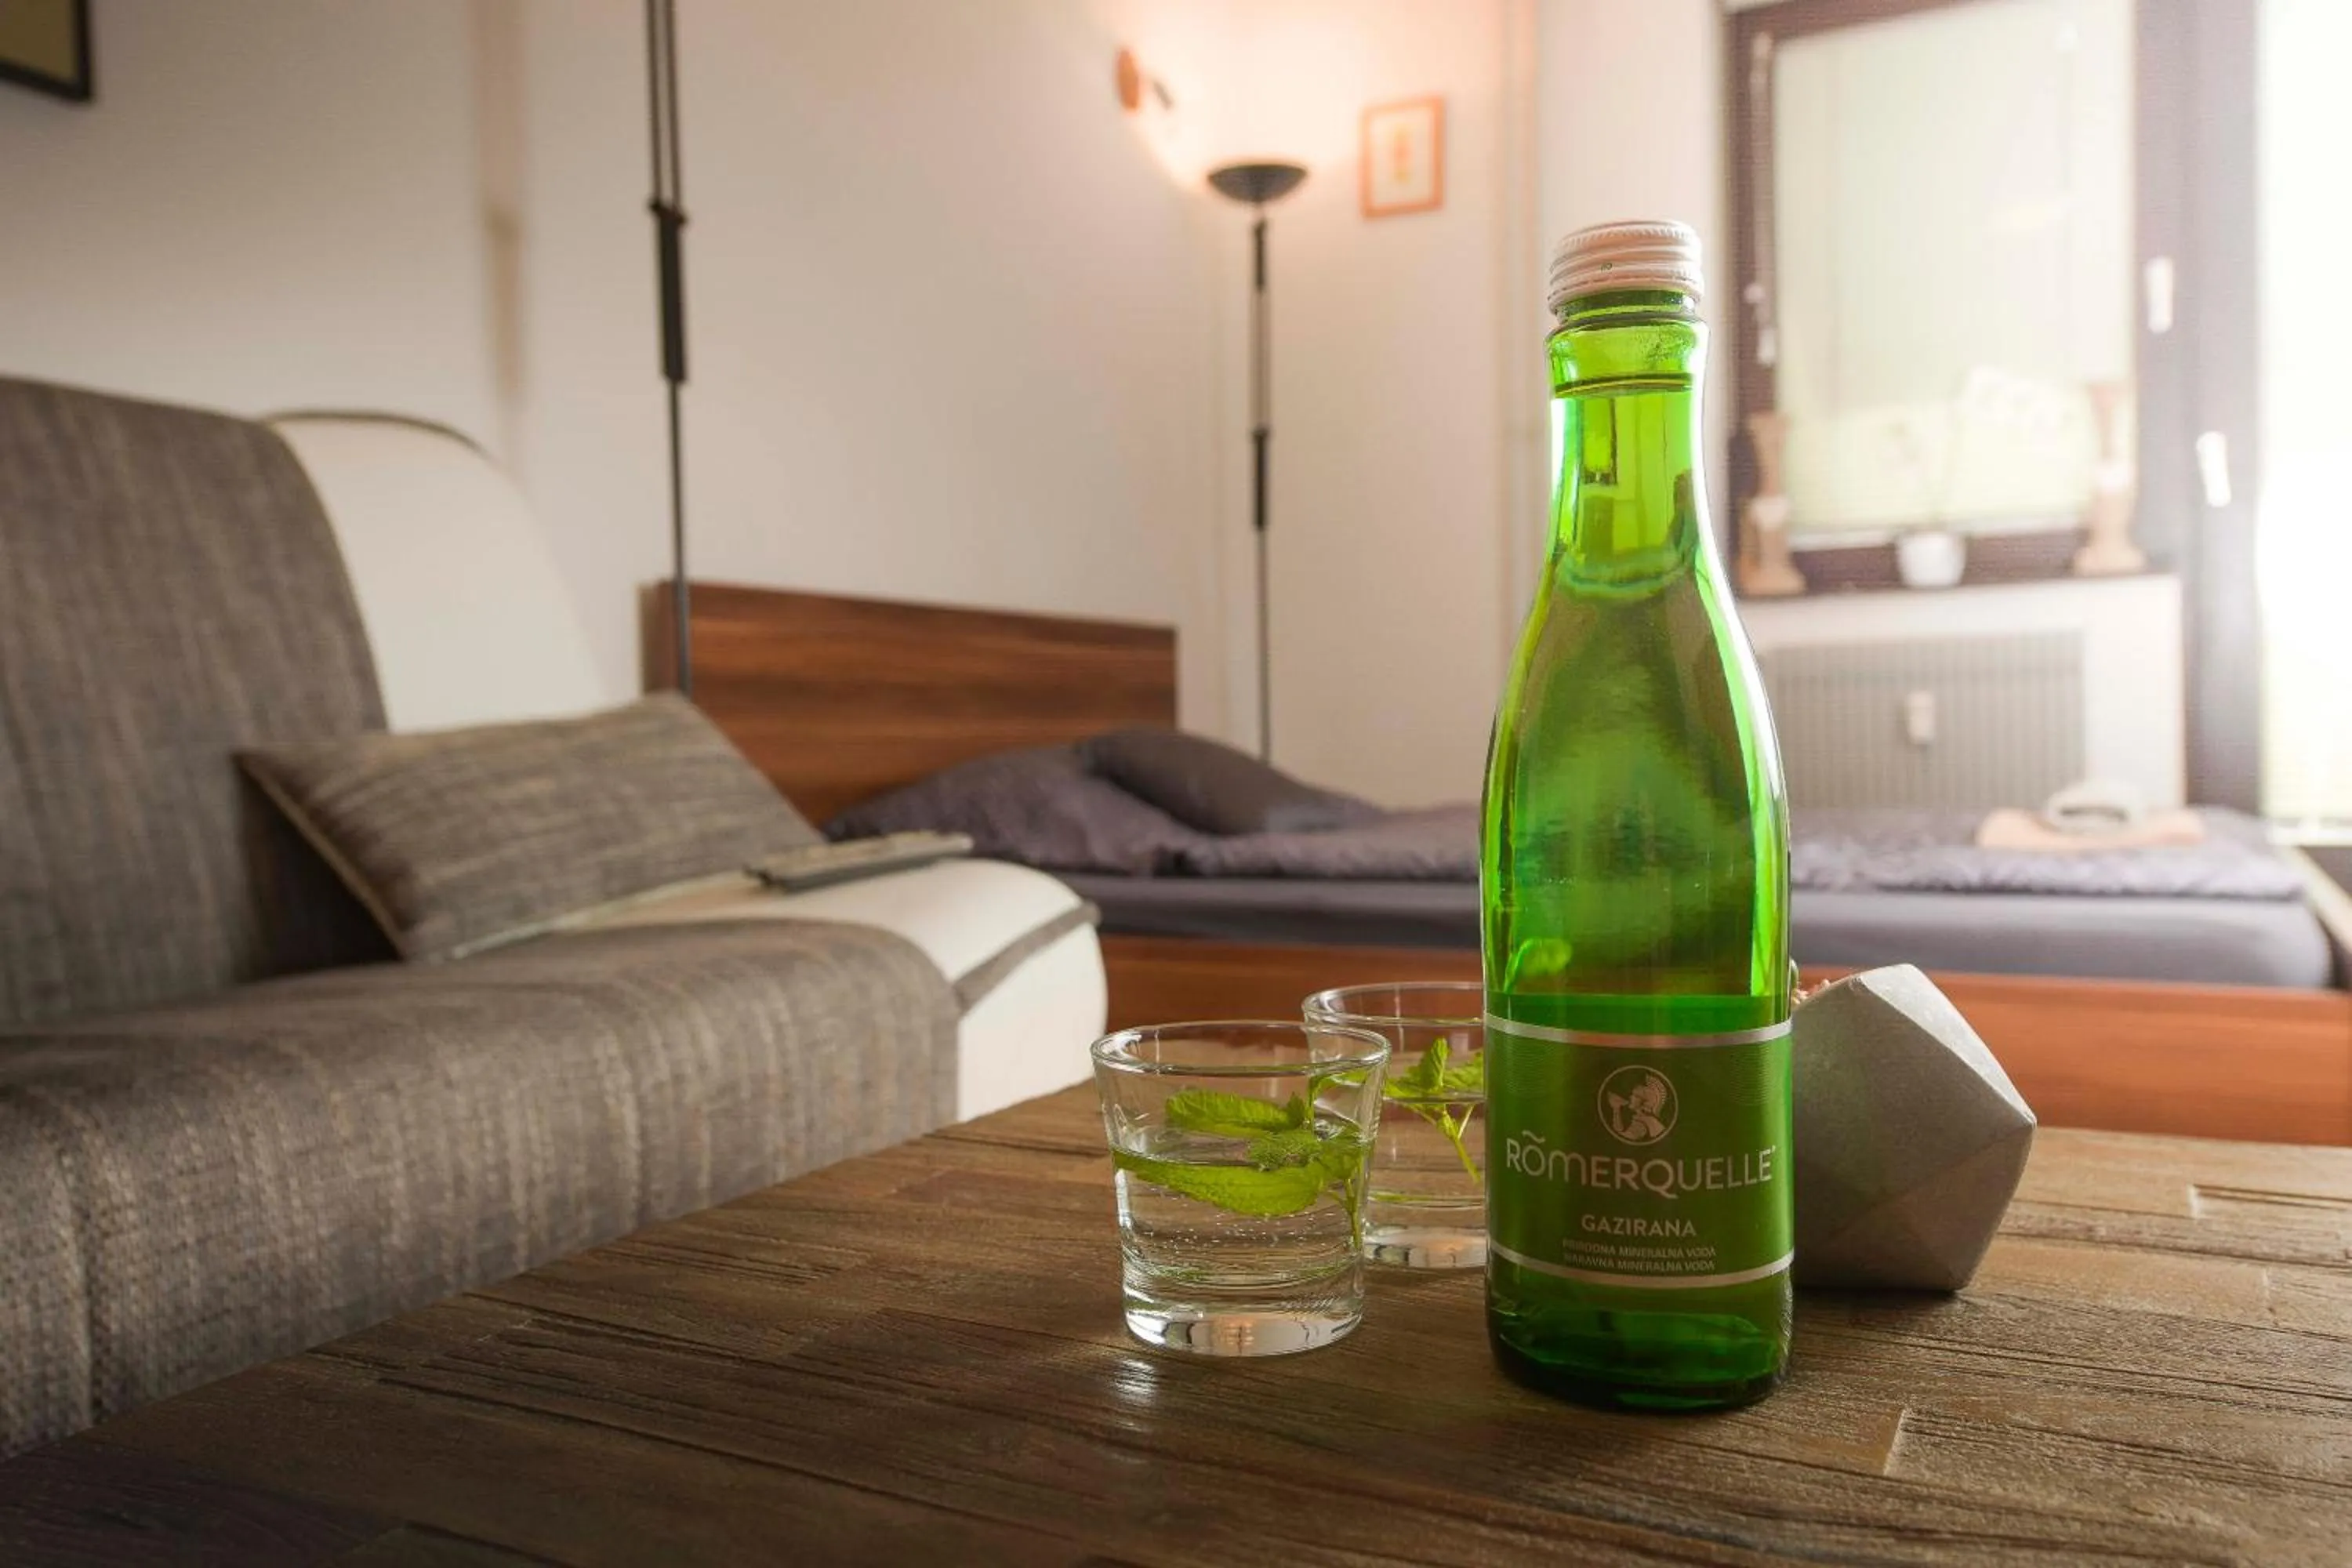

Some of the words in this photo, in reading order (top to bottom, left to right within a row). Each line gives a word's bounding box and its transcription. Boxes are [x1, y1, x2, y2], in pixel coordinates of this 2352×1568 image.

[1581, 1214, 1697, 1237] GAZIRANA
[1617, 1258, 1682, 1272] MINERALNA
[1684, 1259, 1715, 1272] VODA
